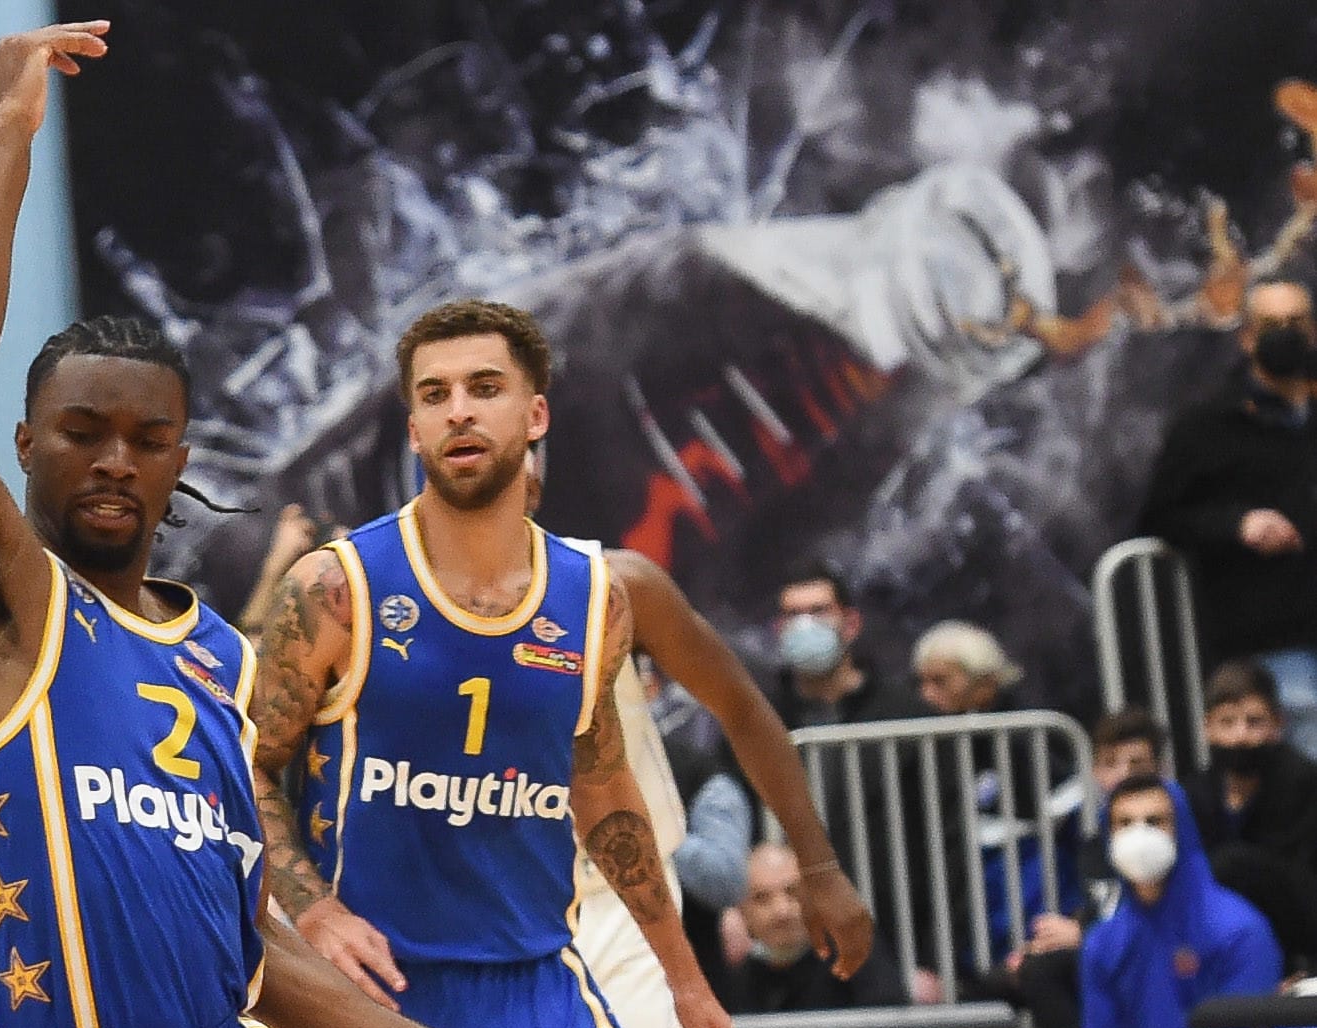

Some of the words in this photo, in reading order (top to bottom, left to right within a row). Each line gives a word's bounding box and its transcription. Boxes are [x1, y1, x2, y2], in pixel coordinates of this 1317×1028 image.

[136, 682, 201, 780] 2
[458, 677, 491, 755] 1
[360, 756, 571, 827] Playtika
